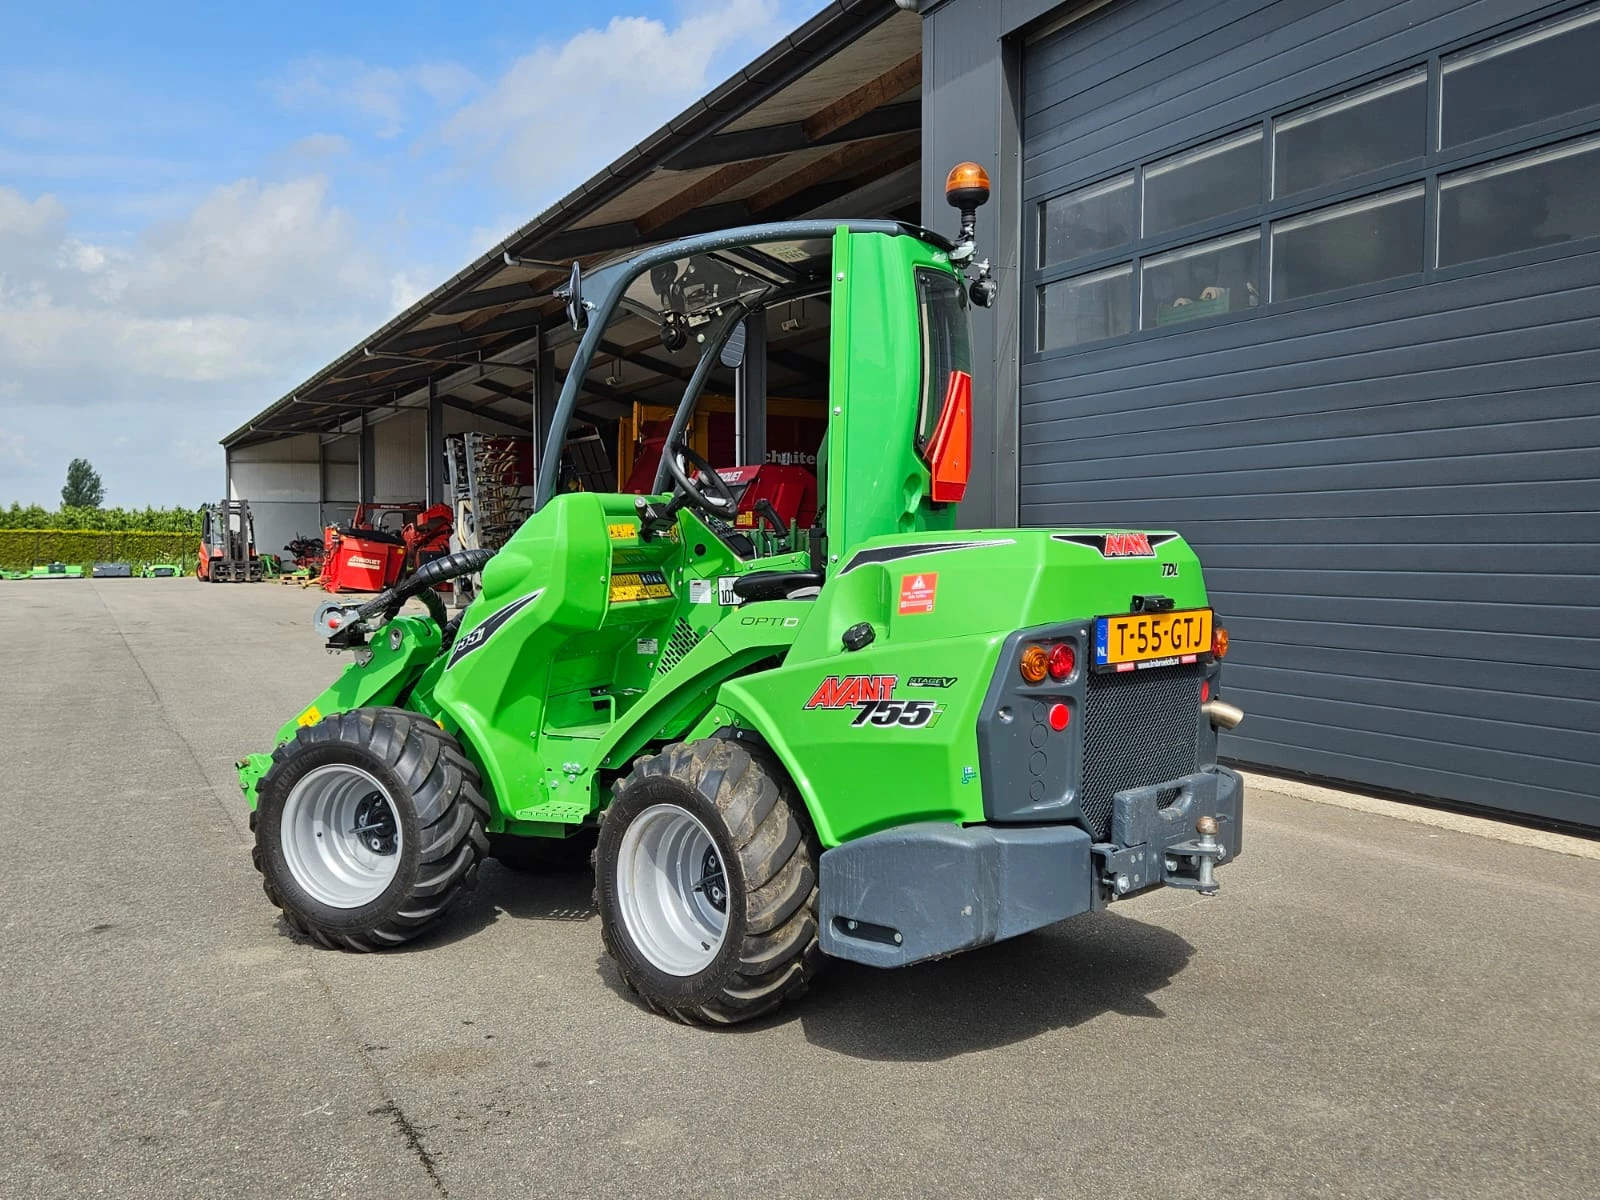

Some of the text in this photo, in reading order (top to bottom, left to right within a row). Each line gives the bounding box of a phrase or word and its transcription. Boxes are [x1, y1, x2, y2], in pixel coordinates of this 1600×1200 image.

[1103, 532, 1156, 557] AVANT
[1096, 645, 1107, 657] NL
[1116, 618, 1203, 656] T-55-GTJ
[803, 675, 899, 710] AVANT
